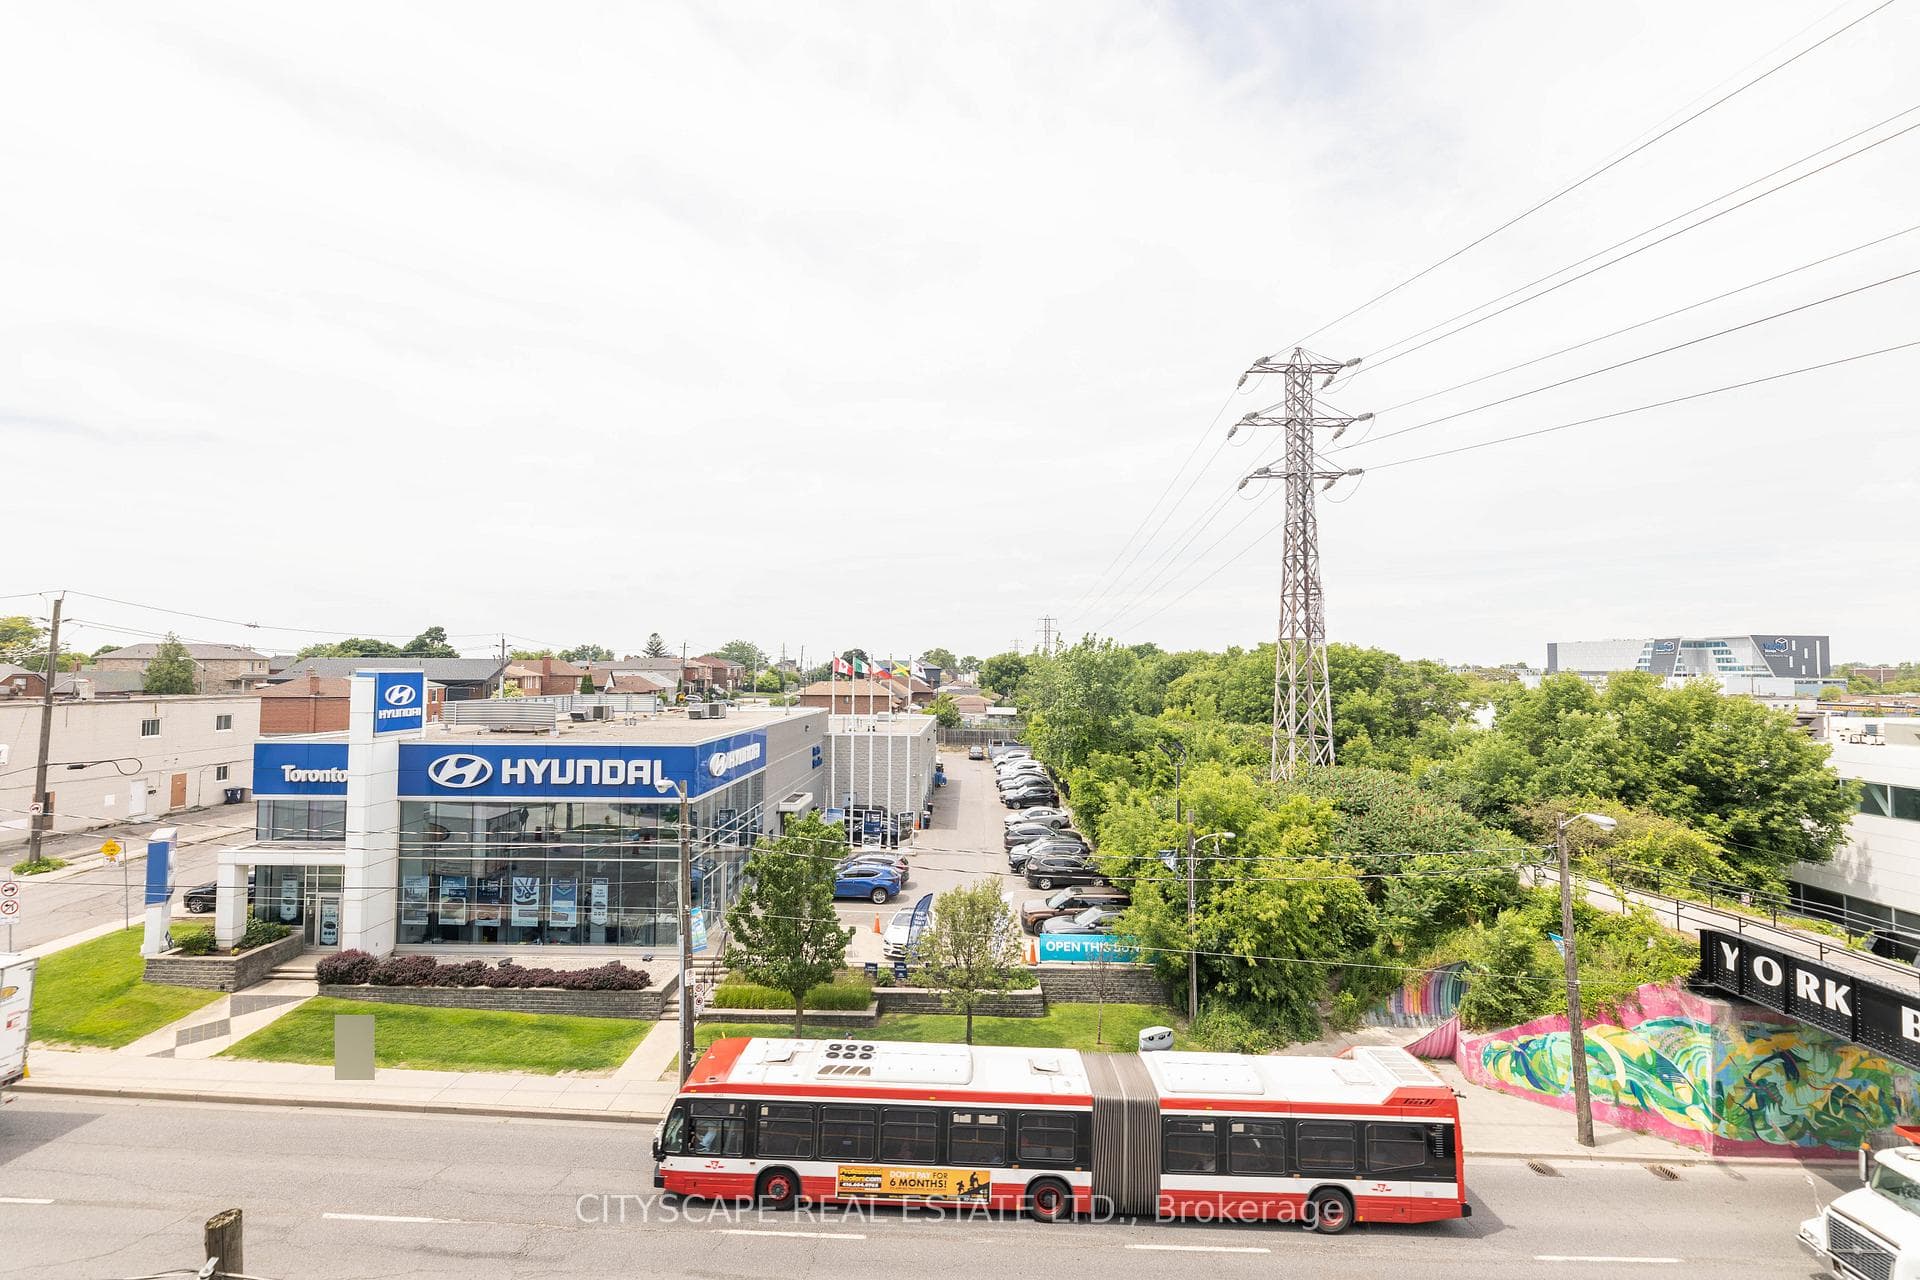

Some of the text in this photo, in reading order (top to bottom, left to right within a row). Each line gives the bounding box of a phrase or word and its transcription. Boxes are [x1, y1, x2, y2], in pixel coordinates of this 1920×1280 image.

[378, 707, 421, 720] HYUNDAI
[281, 764, 349, 782] Toronto
[501, 758, 662, 785] HYUNDAI
[1045, 941, 1081, 952] OPEN
[1082, 942, 1111, 953] THIS
[1720, 941, 1852, 1017] YORK
[932, 1172, 948, 1180] FOR
[890, 1178, 897, 1187] 6
[898, 1178, 947, 1189] MONTHS!
